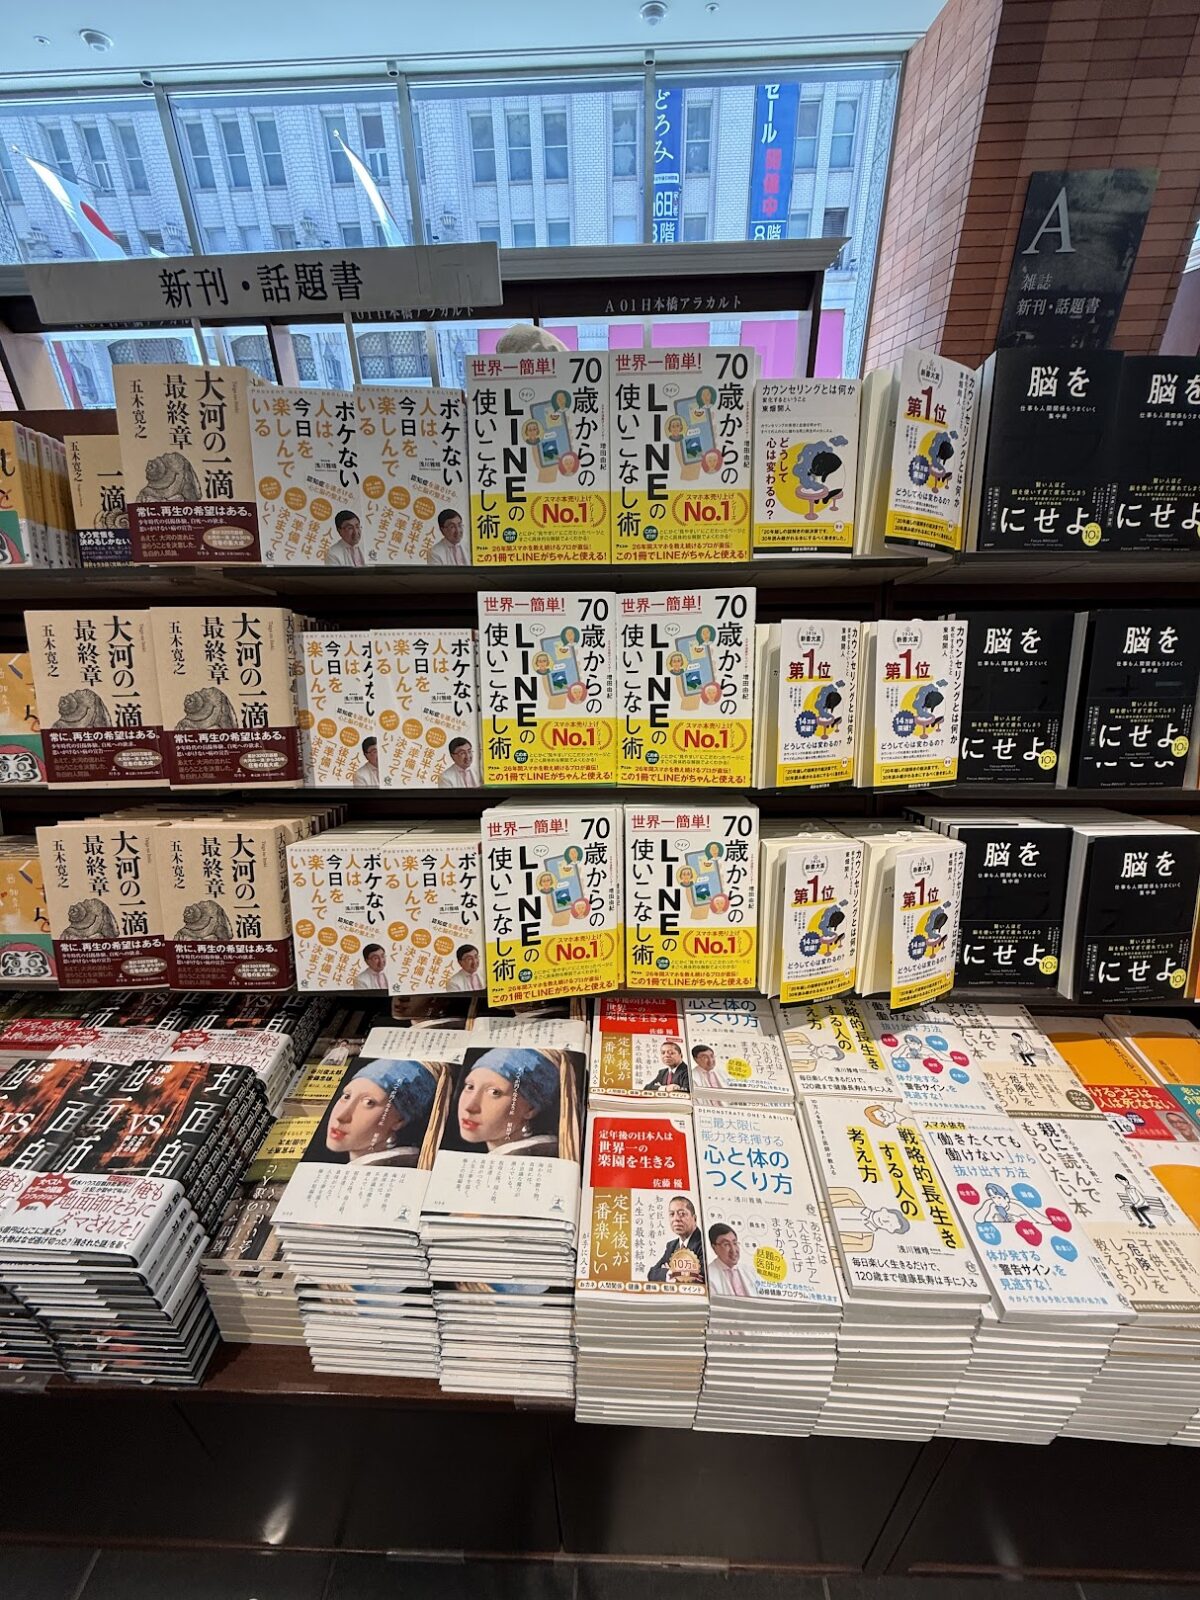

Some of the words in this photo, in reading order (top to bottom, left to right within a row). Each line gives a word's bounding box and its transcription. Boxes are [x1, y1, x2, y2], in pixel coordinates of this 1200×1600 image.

[762, 84, 780, 144] セール
[1022, 187, 1076, 255] A
[158, 260, 363, 309] 新刊・話題書
[1021, 273, 1052, 291] 雑誌
[1016, 297, 1099, 316] 新刊・話題書
[472, 358, 556, 376] 世界一簡単!
[616, 353, 702, 371] 世界一簡単!
[1027, 366, 1089, 397] 脳を
[129, 378, 147, 439] 五木寛之
[762, 385, 855, 396] カウンセリングとは何か
[907, 386, 947, 424] 第1位
[165, 374, 192, 450] 最終章
[357, 398, 375, 436] いる
[398, 397, 417, 458] 今日を
[195, 370, 234, 499] 大河の一滴
[335, 401, 359, 487] ボケない
[377, 397, 399, 477] 楽しんで
[440, 399, 463, 486] ボケない
[503, 389, 527, 521] LINEの
[645, 384, 669, 519] LINEの
[71, 441, 83, 482] 五木寛之
[473, 389, 500, 539] 使いこなし術
[616, 384, 641, 537] 使いこなし術
[766, 437, 776, 520] 心は変わるの?
[780, 438, 789, 483] どうして
[542, 503, 587, 523] No.1
[684, 500, 729, 521] No.1
[1001, 507, 1089, 535] にせよ
[484, 597, 565, 613] 世界一簡単!
[169, 621, 186, 675] 五木寛之
[202, 616, 229, 685] 最終章
[375, 641, 391, 674] いる
[984, 627, 1041, 654] 脳を
[1123, 626, 1179, 654] 脳を
[104, 615, 142, 727] 大河の一滴
[232, 612, 269, 728] 大河の一滴
[393, 639, 412, 711] 楽しんで
[412, 639, 430, 692] 今日を
[451, 639, 472, 717] ボケない
[515, 623, 537, 745] LINEの
[789, 649, 831, 679] 第1位
[885, 649, 930, 680] 第1位
[950, 626, 964, 744] カウンセリングとは何か
[484, 623, 512, 760] 使いこなし術
[382, 732, 393, 753] いく
[552, 728, 595, 747] No.1
[962, 737, 1045, 760] にせよ
[1100, 723, 1179, 748] にせよ
[632, 814, 710, 829] 世界一簡単!
[52, 840, 70, 888] 五木寛之
[83, 835, 109, 896] 最終章
[384, 858, 400, 889] いる
[984, 842, 1040, 867] 脳を
[1121, 851, 1176, 877] 脳を
[111, 830, 148, 936] 大河の一滴
[228, 833, 261, 939] 大河の一滴
[363, 854, 385, 925] ボケない
[402, 856, 421, 921] 楽しんで
[421, 854, 438, 904] 今日を
[458, 853, 479, 925] ボケない
[659, 839, 680, 952] LINEの
[794, 875, 834, 904] 第1位
[631, 839, 654, 965] 使いこなし術
[694, 937, 737, 954] No.1
[1098, 958, 1177, 983] にせよ
[696, 1013, 758, 1027] つくり方
[599, 1131, 673, 1141] 定年後の日本人は
[702, 1130, 783, 1146] 能力を発揮する
[714, 1118, 760, 1131] 最大限に
[924, 1121, 966, 1130] スマホ依存
[598, 1154, 675, 1168] 楽園を生きる
[599, 1141, 648, 1154] 世界一の
[704, 1145, 789, 1168] 心と体の
[847, 1129, 878, 1183] 考え方
[1037, 1122, 1100, 1202] 親に読んで
[707, 1170, 792, 1194] つくり方
[879, 1144, 918, 1216] する人の
[897, 1127, 957, 1248] 戦略的長生き
[954, 1166, 1030, 1179] 抜け出す方法
[1022, 1122, 1092, 1218] もらいたい本
[55, 1190, 156, 1216] 地面師たちに
[594, 1194, 612, 1273] 一番楽しい
[611, 1195, 629, 1266] 定年後が
[635, 1197, 645, 1272] 人生の最終結論
[785, 1219, 803, 1272] をいつ上げ
[810, 1222, 827, 1264] あなたは
[757, 1248, 780, 1261] 話題の
[757, 1259, 781, 1271] 医師が
[852, 1258, 941, 1271] 毎日楽しく生きるだけで、
[986, 1250, 1041, 1261] 体が発する
[1094, 1238, 1136, 1296] 教えよう
[1137, 1239, 1175, 1281] 子供に
[855, 1271, 977, 1287] 120歳まで健康長寿は手に入る
